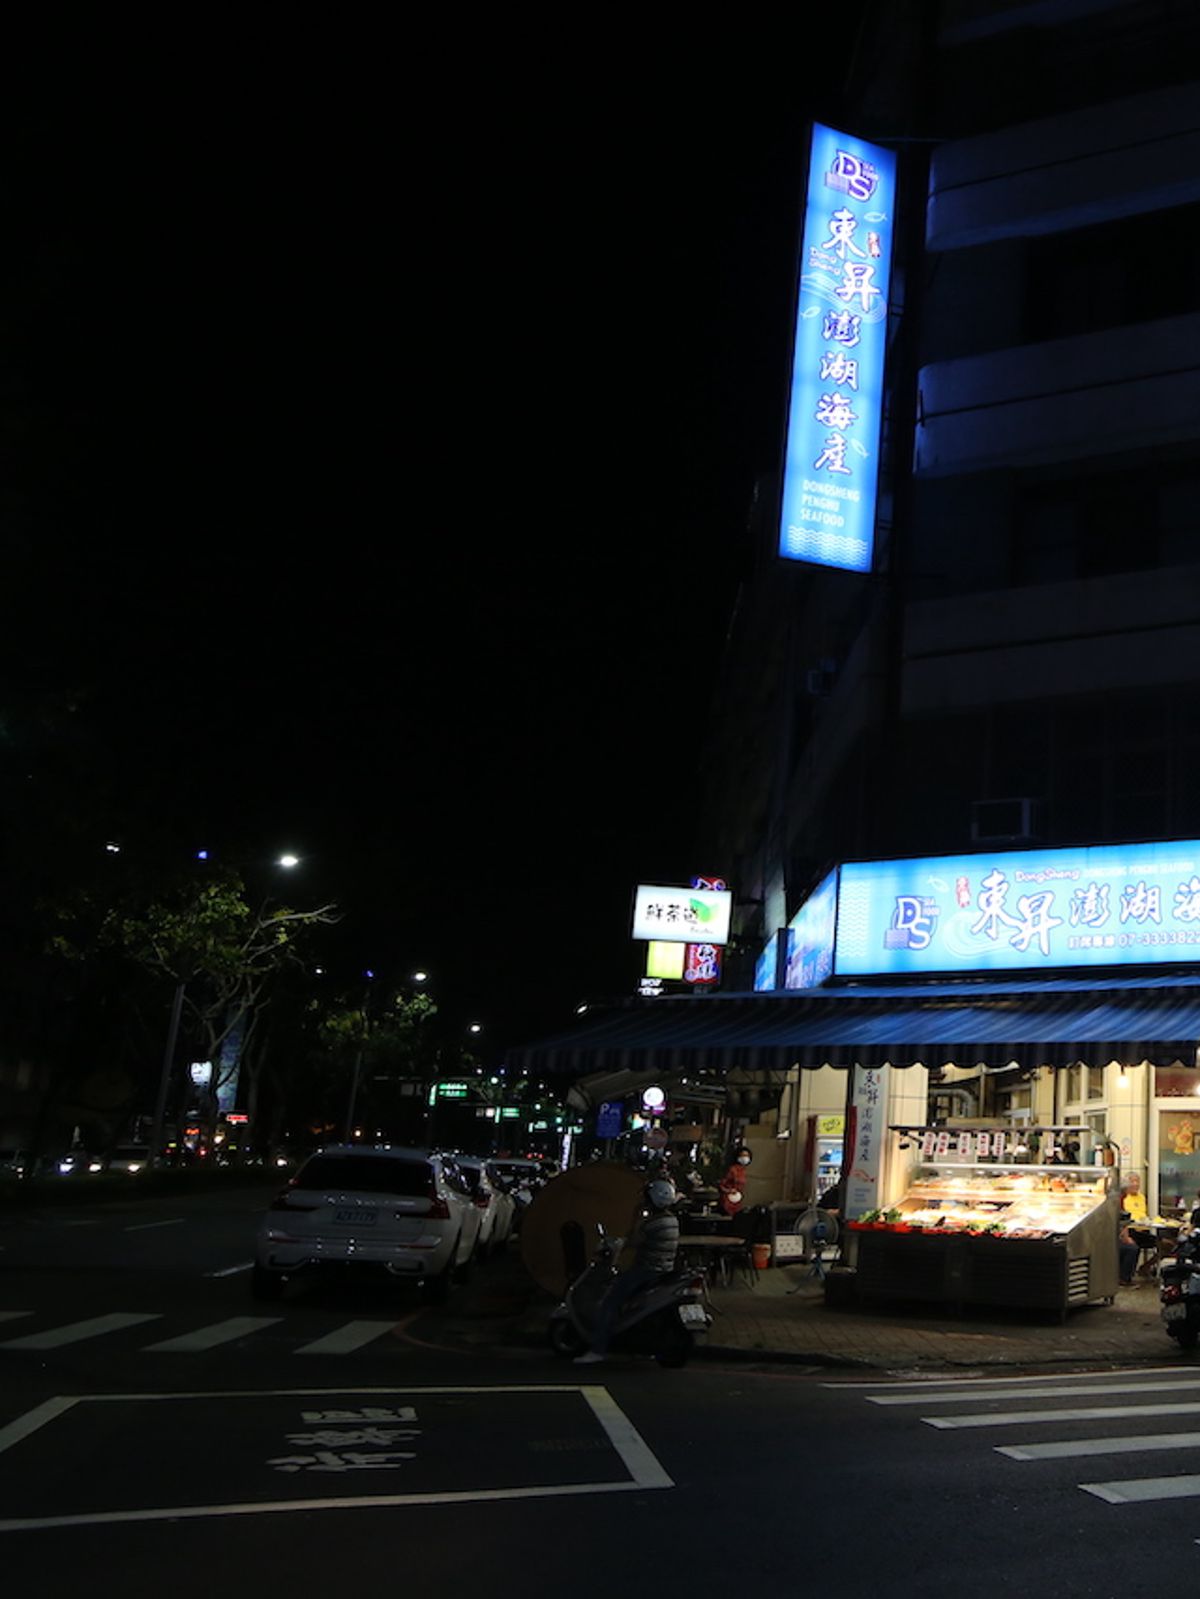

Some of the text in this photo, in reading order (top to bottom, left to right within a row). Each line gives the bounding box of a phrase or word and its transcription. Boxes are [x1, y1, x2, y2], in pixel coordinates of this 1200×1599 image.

[815, 206, 880, 475] 東昇澎湖海產
[800, 508, 844, 528] SEAFOOD
